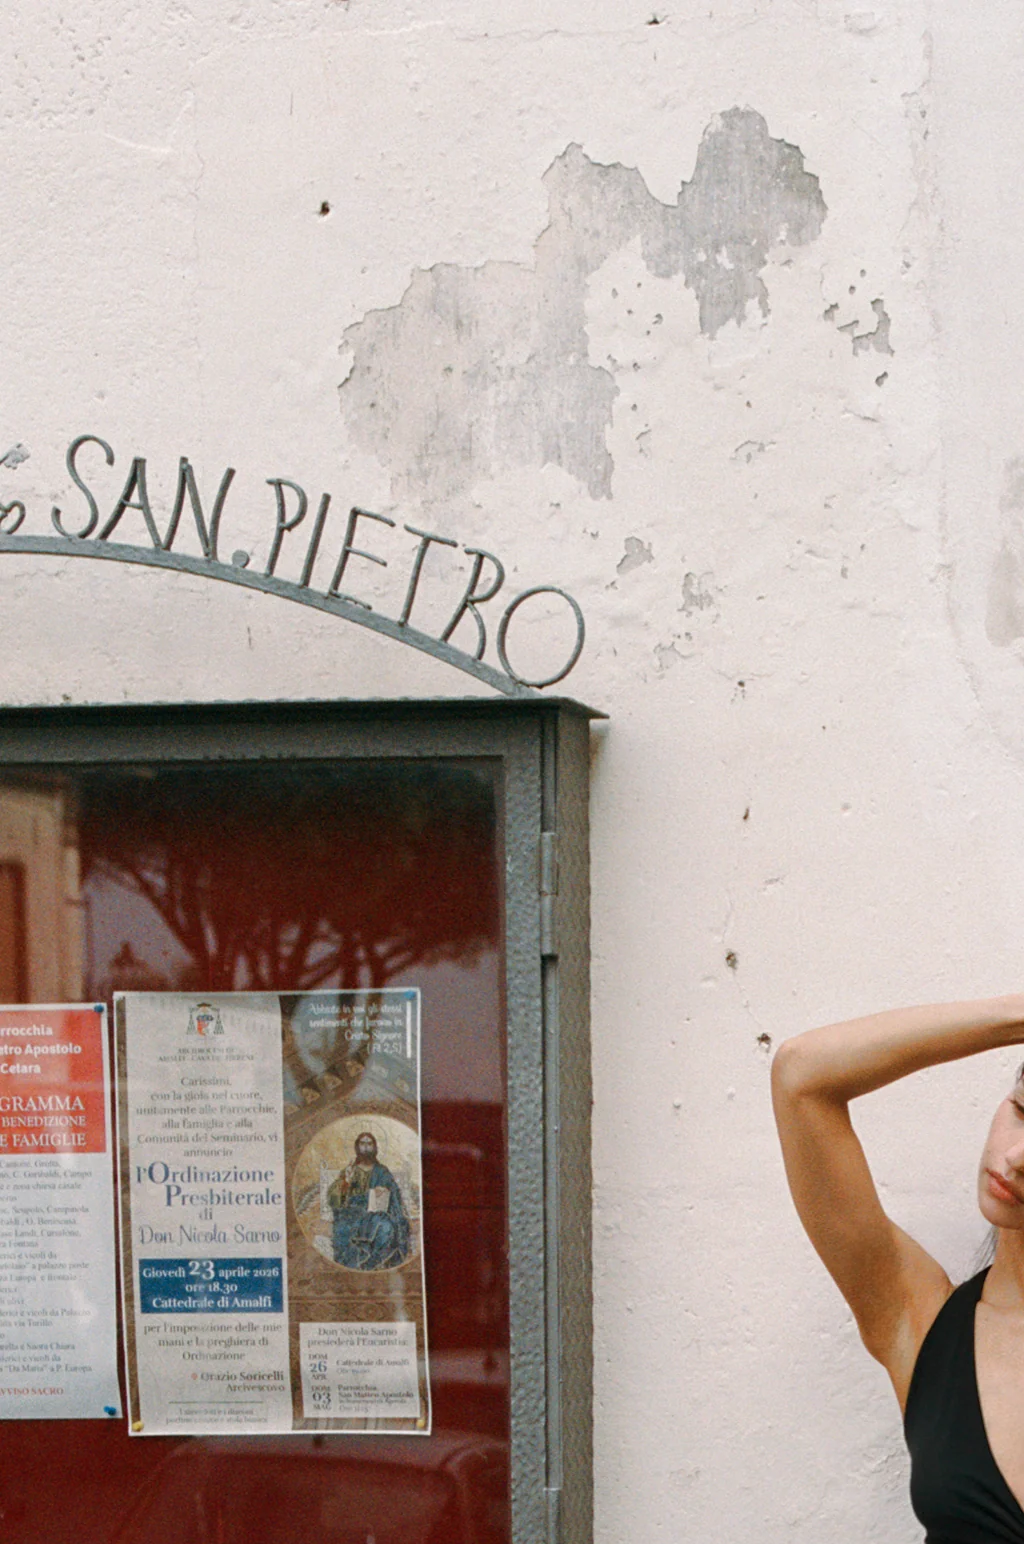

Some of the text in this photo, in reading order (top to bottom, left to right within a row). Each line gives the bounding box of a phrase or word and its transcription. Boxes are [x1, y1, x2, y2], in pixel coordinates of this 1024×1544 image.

[24, 1043, 82, 1058] Apostolo
[0, 1063, 41, 1074] Cetara
[150, 1093, 168, 1101] con
[172, 1091, 182, 1100] la
[2, 1115, 87, 1127] BENEDIZIONE
[161, 1119, 180, 1129] alla
[182, 1118, 224, 1131] famiglia
[234, 1118, 253, 1129] alla
[12, 1132, 87, 1147] FAMIGLIE
[165, 1184, 282, 1207] Presbiterale
[199, 1207, 213, 1220] di
[138, 1223, 281, 1247] Don Nicola Sarno
[142, 1260, 279, 1280] Giovedì 23 aprile 2026
[185, 1281, 238, 1295] ore 18.30
[152, 1295, 272, 1308] Cattedrale di Amalfi
[143, 1325, 161, 1335] per
[235, 1322, 260, 1333] delle
[262, 1323, 282, 1333] mie
[158, 1337, 185, 1347] mani
[258, 1335, 269, 1346] di
[309, 1360, 328, 1373] 26
[200, 1370, 284, 1381] Orazio Soricelli
[226, 1383, 286, 1392] Arcivescovo
[312, 1391, 331, 1405] 03
